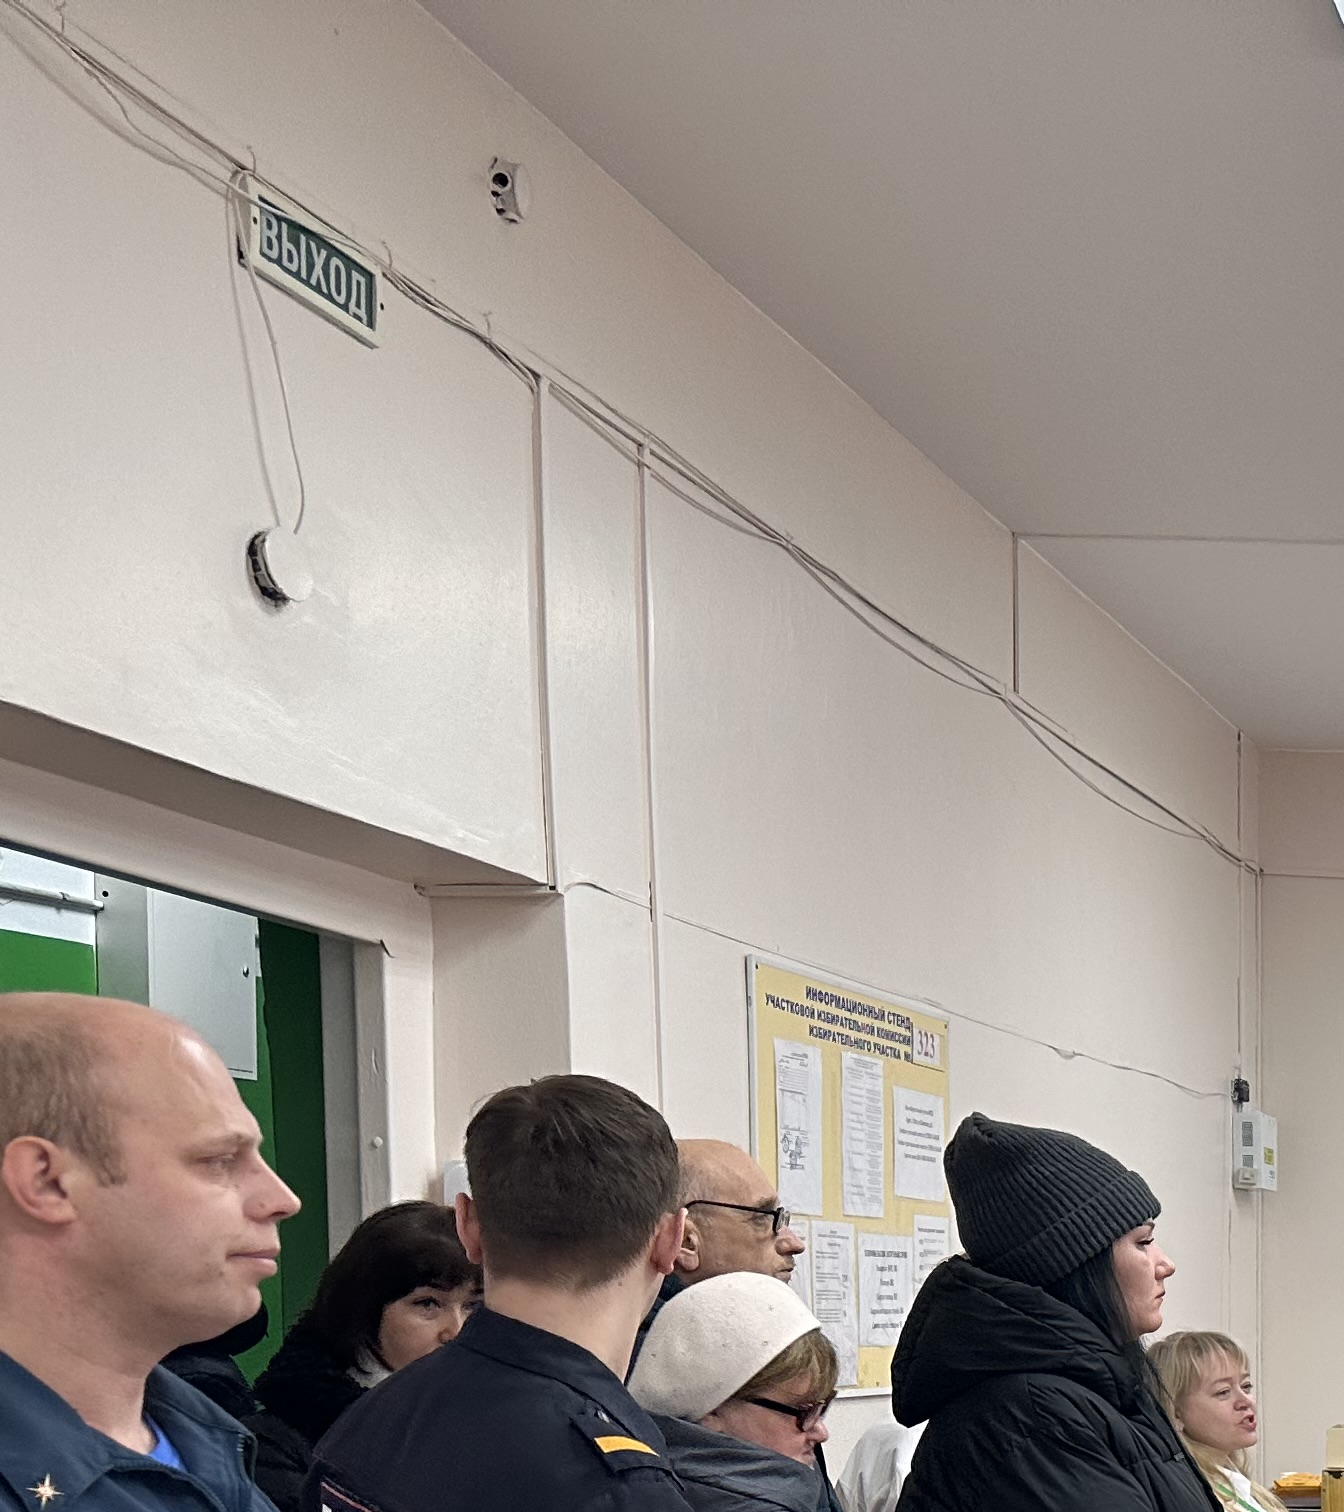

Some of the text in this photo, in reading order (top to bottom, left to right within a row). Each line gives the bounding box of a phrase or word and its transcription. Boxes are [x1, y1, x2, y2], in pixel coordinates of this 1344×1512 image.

[261, 213, 369, 326] ВЫХОД
[765, 992, 911, 1047] УЧАСТКОВОЙ ИЗБИРАТЕЛЬНОЙ КОМИССИИ
[805, 985, 911, 1033] ИНФОРМАЦИОННЫЙ СТЕНД
[808, 1024, 872, 1052] ИЗБИРАТЕЛЬНОГО
[873, 1041, 901, 1060] УЧАСТКА
[917, 1030, 935, 1058] 323
